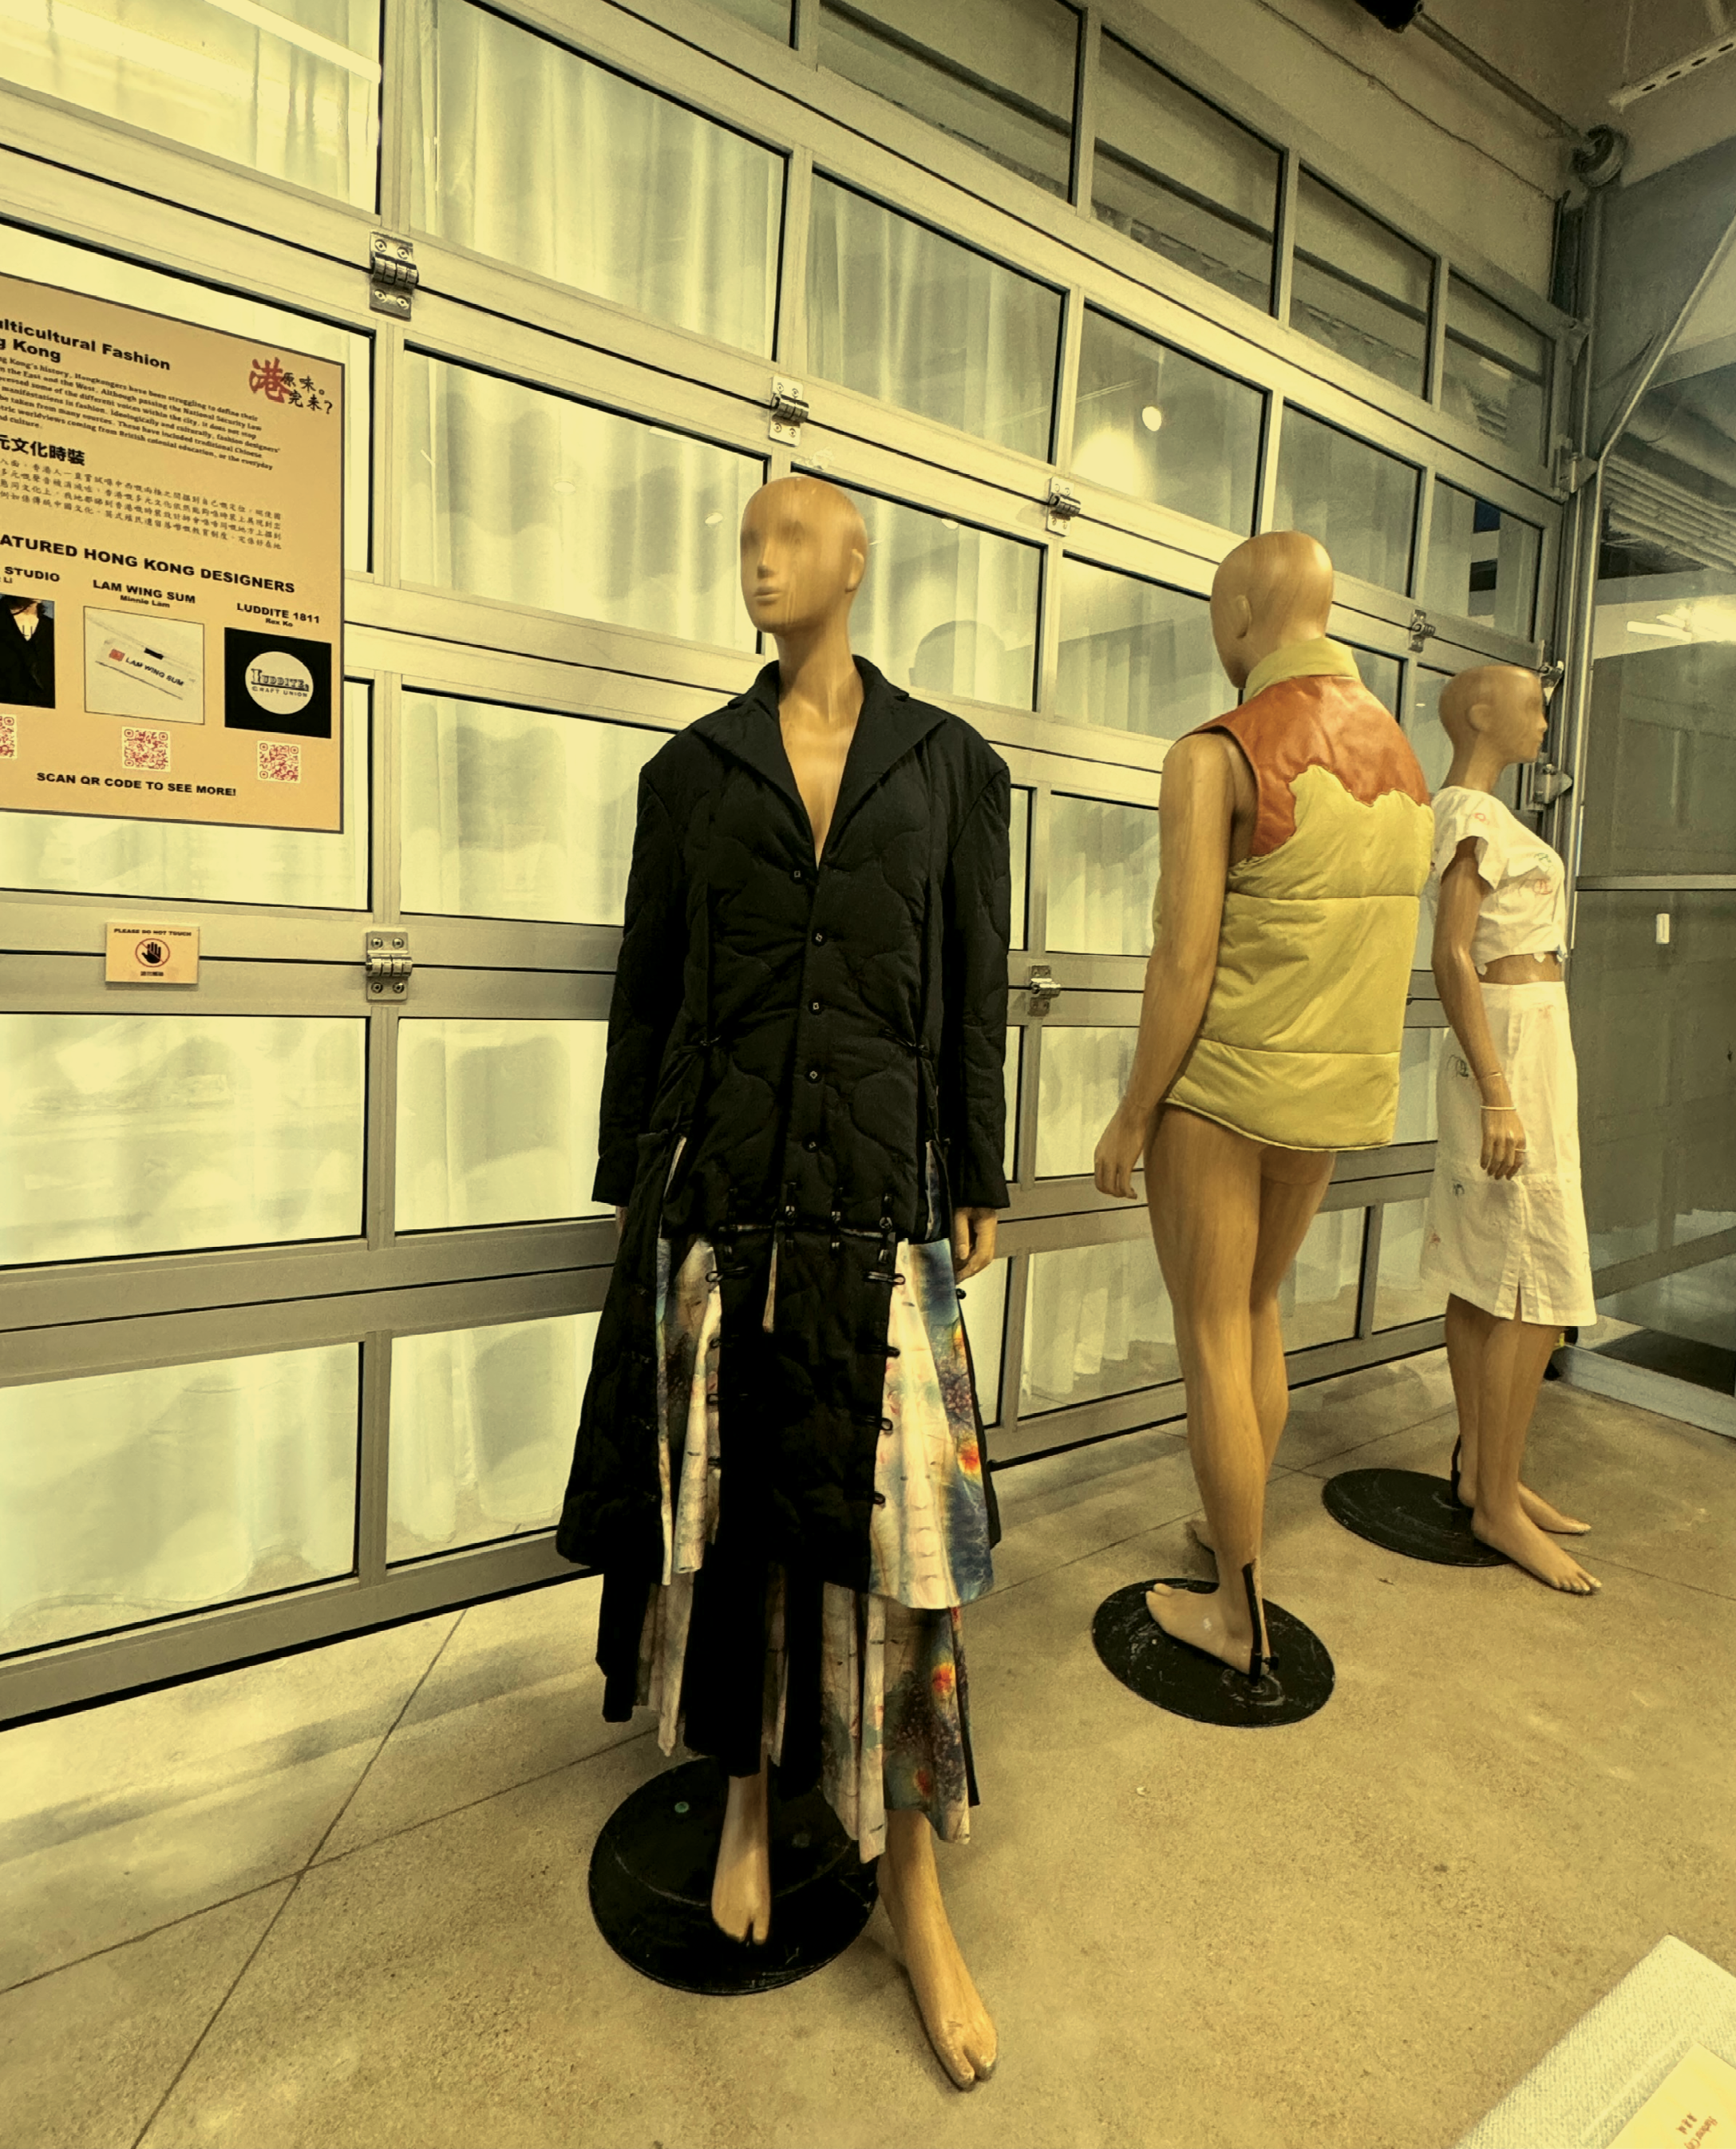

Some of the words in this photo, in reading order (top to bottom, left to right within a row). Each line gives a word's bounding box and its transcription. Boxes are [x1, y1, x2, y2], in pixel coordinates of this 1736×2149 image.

[13, 338, 60, 363] Kong
[101, 342, 169, 370] Fashion
[1, 386, 63, 404] manifestations
[78, 393, 115, 406] different
[142, 408, 168, 418] within
[168, 395, 207, 410] struggling
[101, 388, 136, 402] Although
[138, 398, 167, 410] passing
[183, 407, 214, 420] National
[216, 415, 245, 429] Security
[17, 408, 65, 424] worldviews
[119, 430, 145, 441] British
[146, 437, 176, 449] colonial
[240, 458, 272, 470] everyday
[161, 430, 192, 442] included
[194, 438, 233, 452] traditional
[234, 447, 262, 458] Chinese
[0, 533, 77, 556] ATURED
[84, 548, 137, 567] HONG
[144, 557, 194, 576] KONG
[200, 568, 295, 592] DESIGNERS
[4, 566, 60, 582] STUDIO
[93, 579, 121, 592] LAM
[125, 584, 162, 598] WING
[166, 591, 195, 604] SUM
[236, 602, 289, 619] LUDDITE
[292, 611, 318, 623] 1811
[125, 657, 143, 667] LAM
[144, 665, 165, 678] WING
[166, 675, 184, 687] SUM
[36, 772, 75, 783] SCAN
[80, 775, 100, 786] QR
[104, 778, 141, 789] CODE
[145, 781, 163, 790] TO
[167, 782, 192, 793] SEE
[196, 785, 235, 796] MORE!
